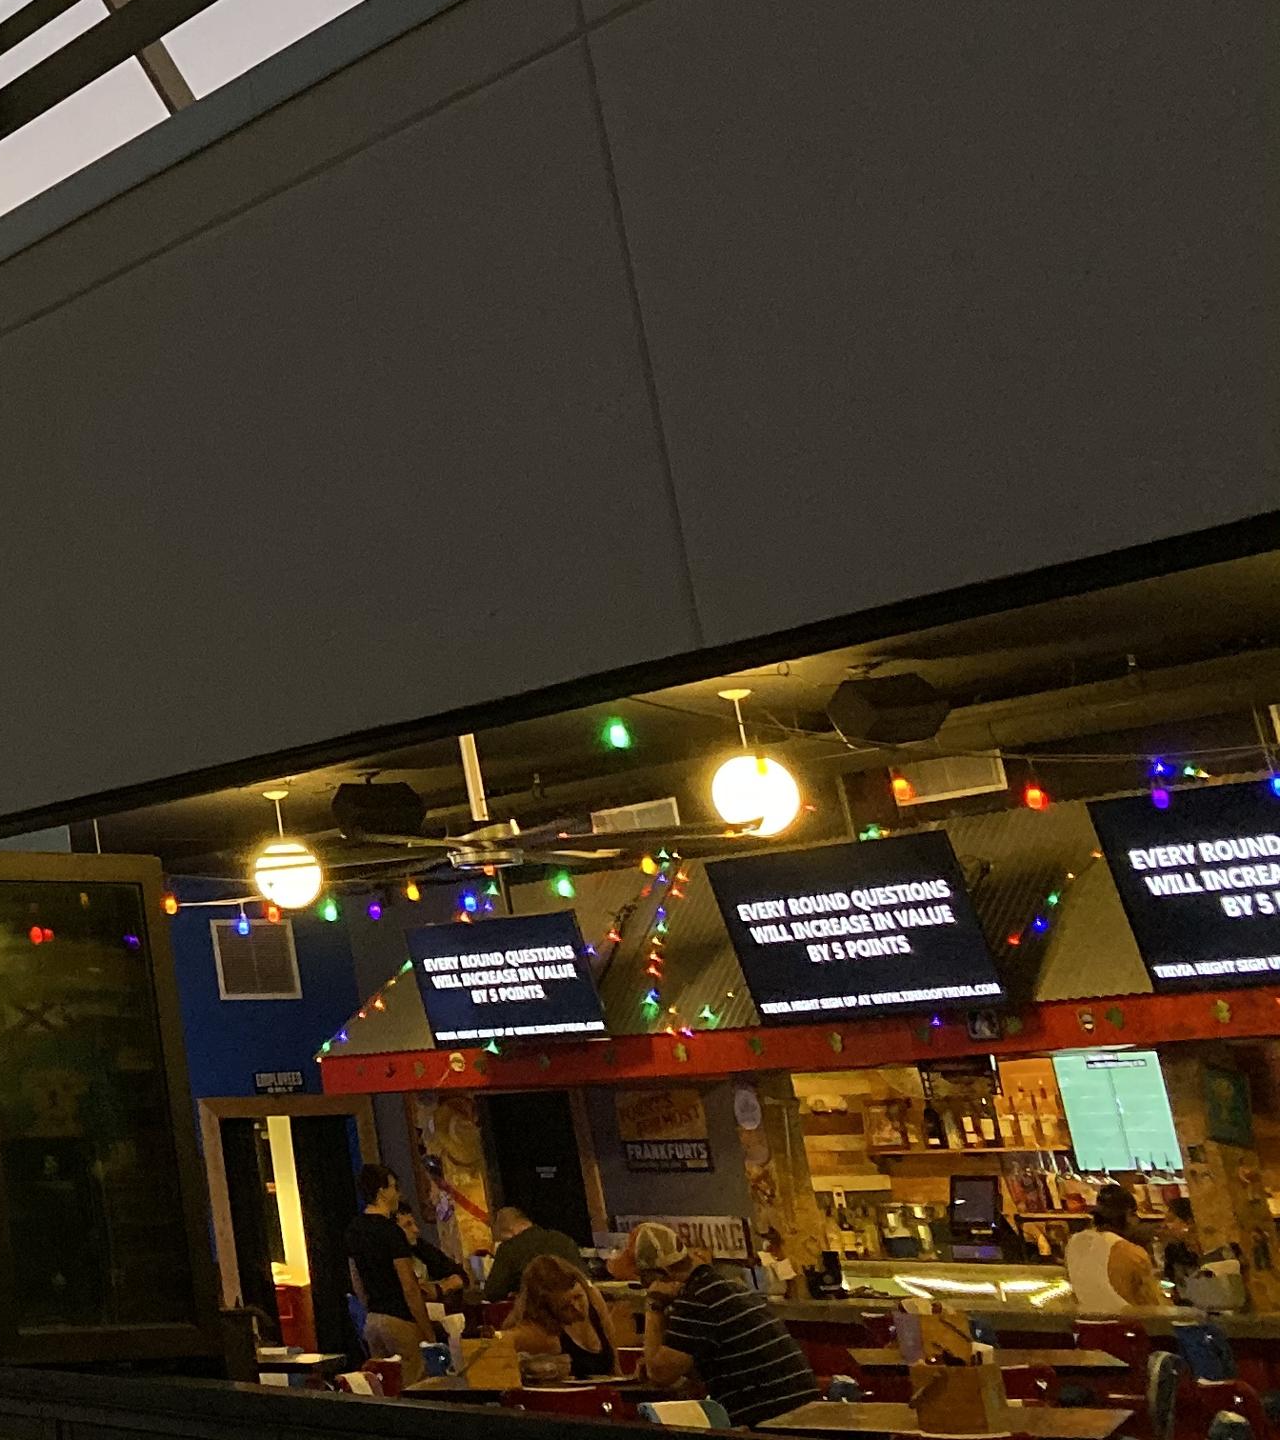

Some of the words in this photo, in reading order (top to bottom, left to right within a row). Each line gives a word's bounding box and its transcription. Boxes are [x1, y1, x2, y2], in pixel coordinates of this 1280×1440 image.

[1128, 842, 1197, 871] EVERY
[1197, 833, 1280, 864] ROUND
[1144, 871, 1205, 896] WILL
[737, 899, 789, 922] EVERY
[787, 892, 851, 917] ROUND
[850, 879, 952, 912] QUESTIONS
[1220, 894, 1254, 918] BY
[749, 924, 794, 945] WILL
[790, 913, 874, 941] INCREASE
[871, 911, 896, 931] IN
[893, 904, 956, 928] VALUE
[423, 956, 461, 973] EVERY
[460, 951, 505, 970] ROUND
[505, 944, 577, 968] QUESTIONS
[806, 943, 832, 963] BY
[845, 934, 912, 959] POINTS
[431, 972, 463, 990] WILL
[461, 967, 519, 987] INCREASE
[518, 966, 537, 983] IN
[536, 963, 578, 980] VALUE
[471, 988, 490, 1005] BY
[499, 983, 546, 1002] POINTS
[625, 1142, 709, 1161] FRANKFURTS
